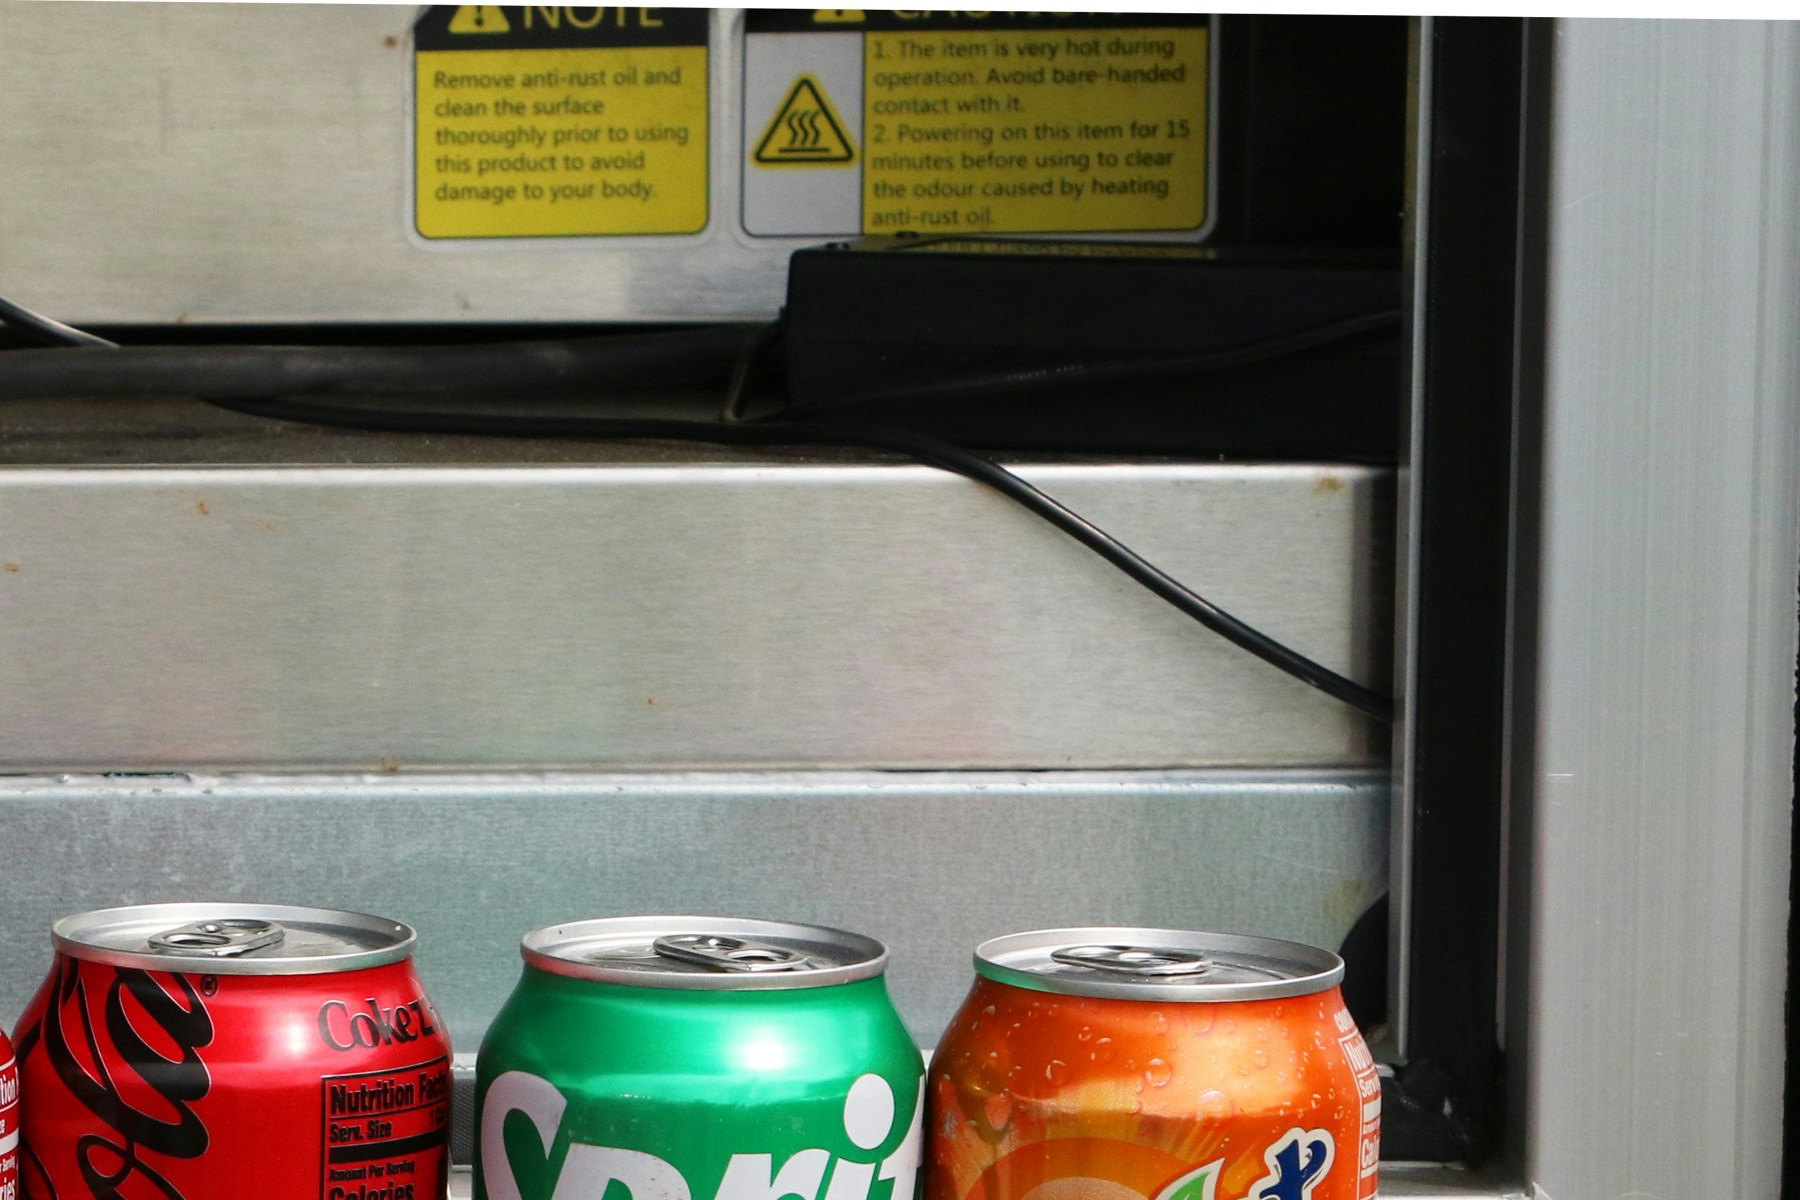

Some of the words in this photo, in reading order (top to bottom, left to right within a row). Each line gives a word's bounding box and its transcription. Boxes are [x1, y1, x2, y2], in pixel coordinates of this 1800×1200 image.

[901, 40, 935, 58] The
[942, 40, 986, 58] item
[995, 39, 1009, 57] is
[1017, 43, 1059, 61] very
[1066, 39, 1100, 57] hot
[1107, 38, 1175, 60] during
[434, 70, 514, 89] Remove
[520, 68, 606, 88] anti-rust
[613, 67, 637, 86] oil
[643, 67, 681, 86] and
[985, 66, 1044, 85] Avoid
[1052, 64, 1185, 84] bare-handed
[434, 98, 488, 117] clean
[494, 97, 526, 116] the
[533, 95, 605, 116] surface
[873, 97, 949, 115] contact
[957, 95, 1000, 113] with
[435, 125, 547, 149] thoroughly
[553, 126, 601, 147] prior
[608, 125, 629, 143] to
[635, 124, 689, 146] using
[898, 124, 993, 146] Powering
[1001, 125, 1027, 141] on
[1035, 121, 1070, 140] this
[1077, 121, 1123, 140] item
[1129, 120, 1158, 138] for
[1166, 120, 1190, 138] 15
[435, 153, 471, 174] this
[478, 152, 557, 177] product
[563, 153, 584, 172] to
[590, 151, 645, 171] avoid
[871, 152, 954, 171] minutes
[962, 150, 1027, 169] before
[1035, 151, 1090, 174] using
[1097, 150, 1118, 168] to
[1125, 148, 1175, 167] clear
[434, 182, 516, 206] damage
[523, 182, 544, 201] to
[549, 183, 595, 204] your
[873, 181, 907, 199] the
[913, 179, 975, 198] odour
[982, 177, 1053, 197] caused
[1060, 177, 1085, 200] by
[1092, 176, 1170, 199] heating
[871, 207, 959, 227] anti-rust
[318, 998, 418, 1053] Coke
[330, 1078, 415, 1115] Nutrition
